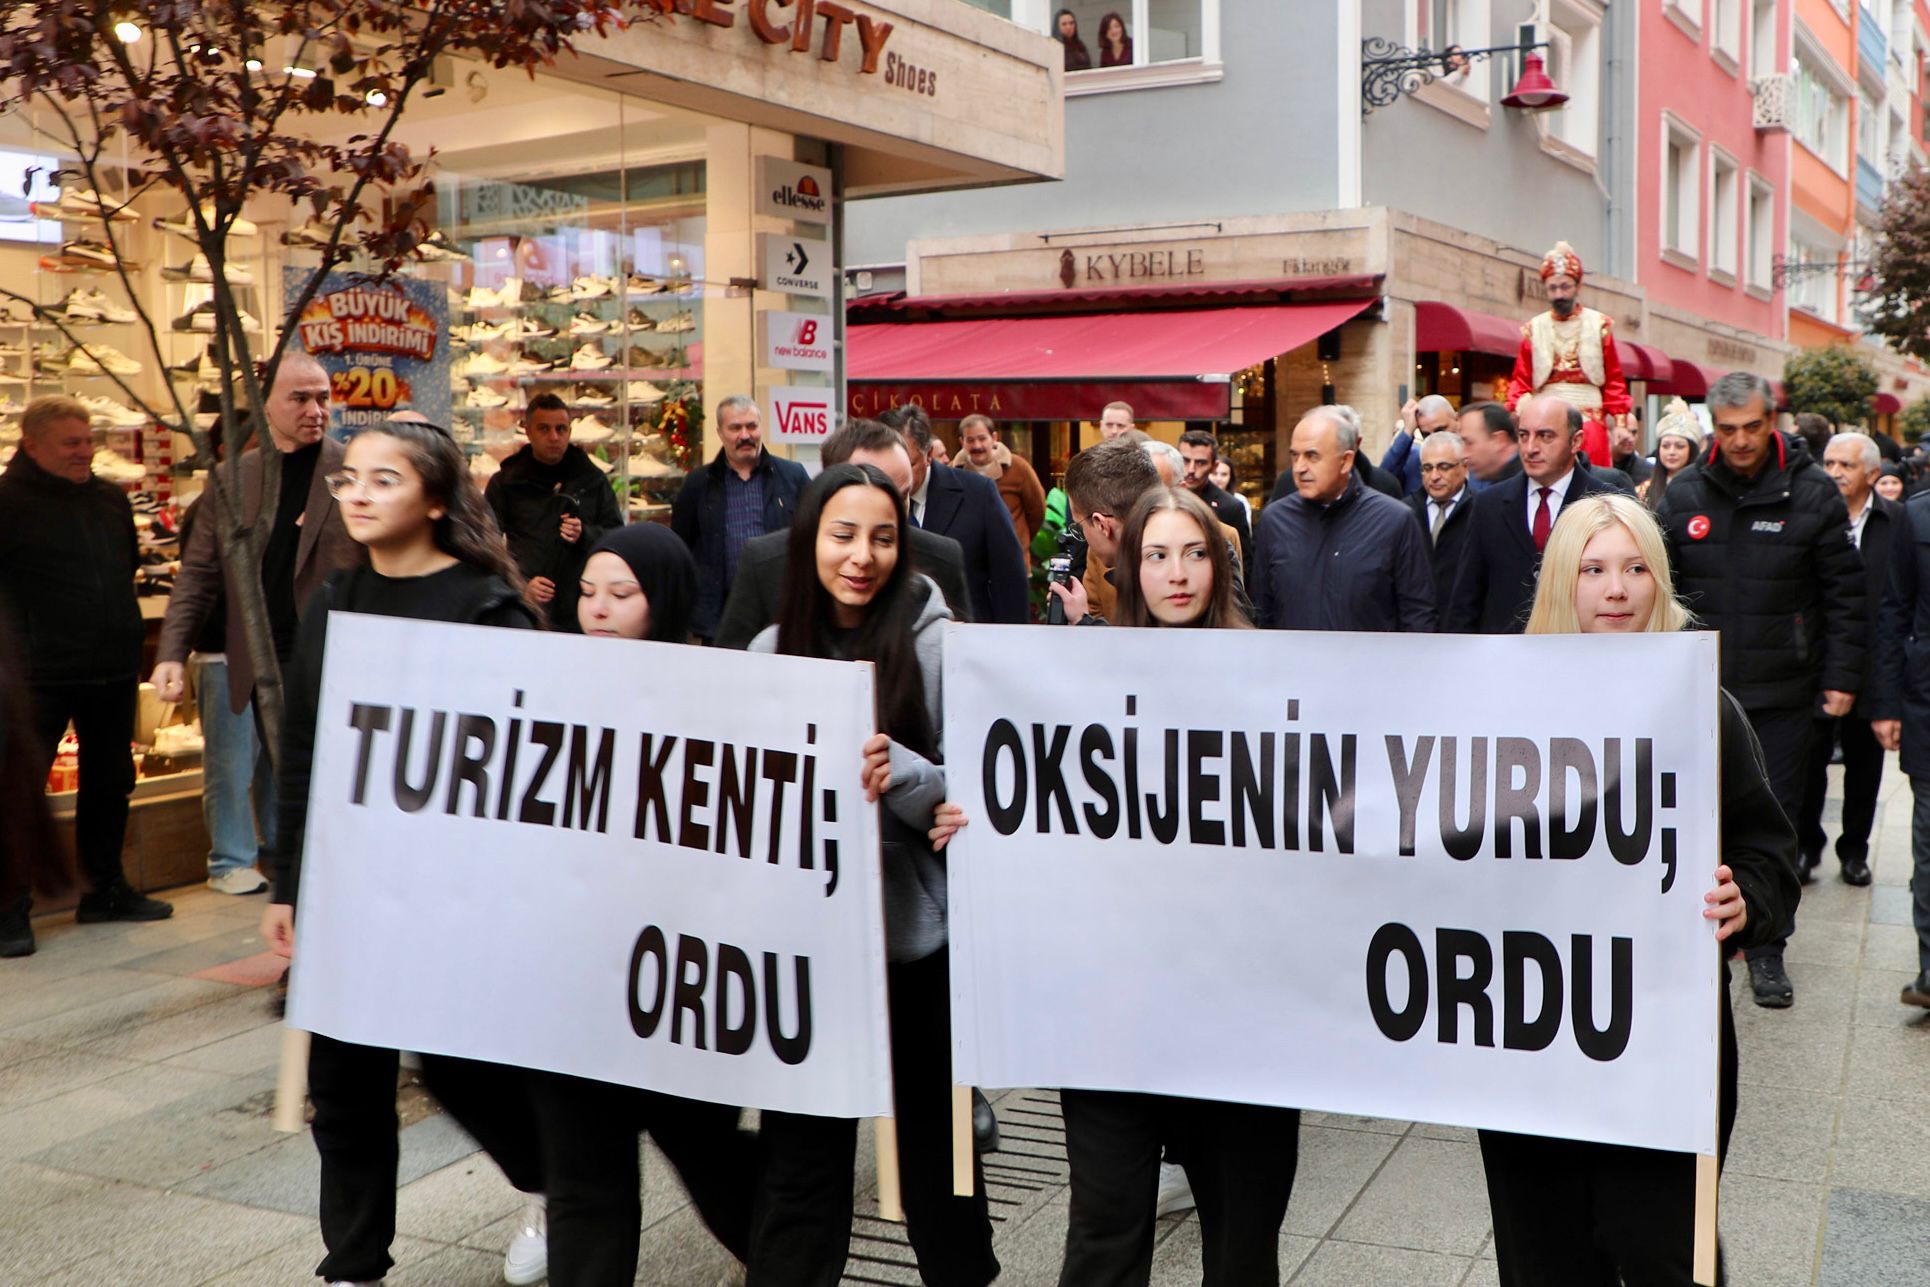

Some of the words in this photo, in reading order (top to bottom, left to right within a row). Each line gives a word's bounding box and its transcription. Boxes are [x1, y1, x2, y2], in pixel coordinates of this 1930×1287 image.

[748, 0, 893, 74] CITY
[884, 51, 937, 97] Shoes
[772, 185, 826, 212] ellesse
[1086, 249, 1205, 280] KYBELE
[776, 276, 819, 290] CONVERSE
[329, 287, 411, 323] BÜYÜK
[304, 321, 344, 350] KIŞ
[774, 346, 792, 356] new
[793, 345, 827, 360] balance
[355, 352, 393, 367] ÜRÜNE
[333, 366, 398, 409] %20
[852, 391, 1002, 414] ÇİKOLATA
[775, 400, 828, 434] VANS
[1751, 520, 1784, 533] AFAD
[349, 689, 617, 834] TURİZM
[632, 722, 840, 898] KENTİ;
[981, 694, 1358, 856] OKSİJENİN
[1384, 734, 1678, 895] YURDU;
[625, 924, 814, 1066] ORDU
[1365, 921, 1634, 1063] ORDU
